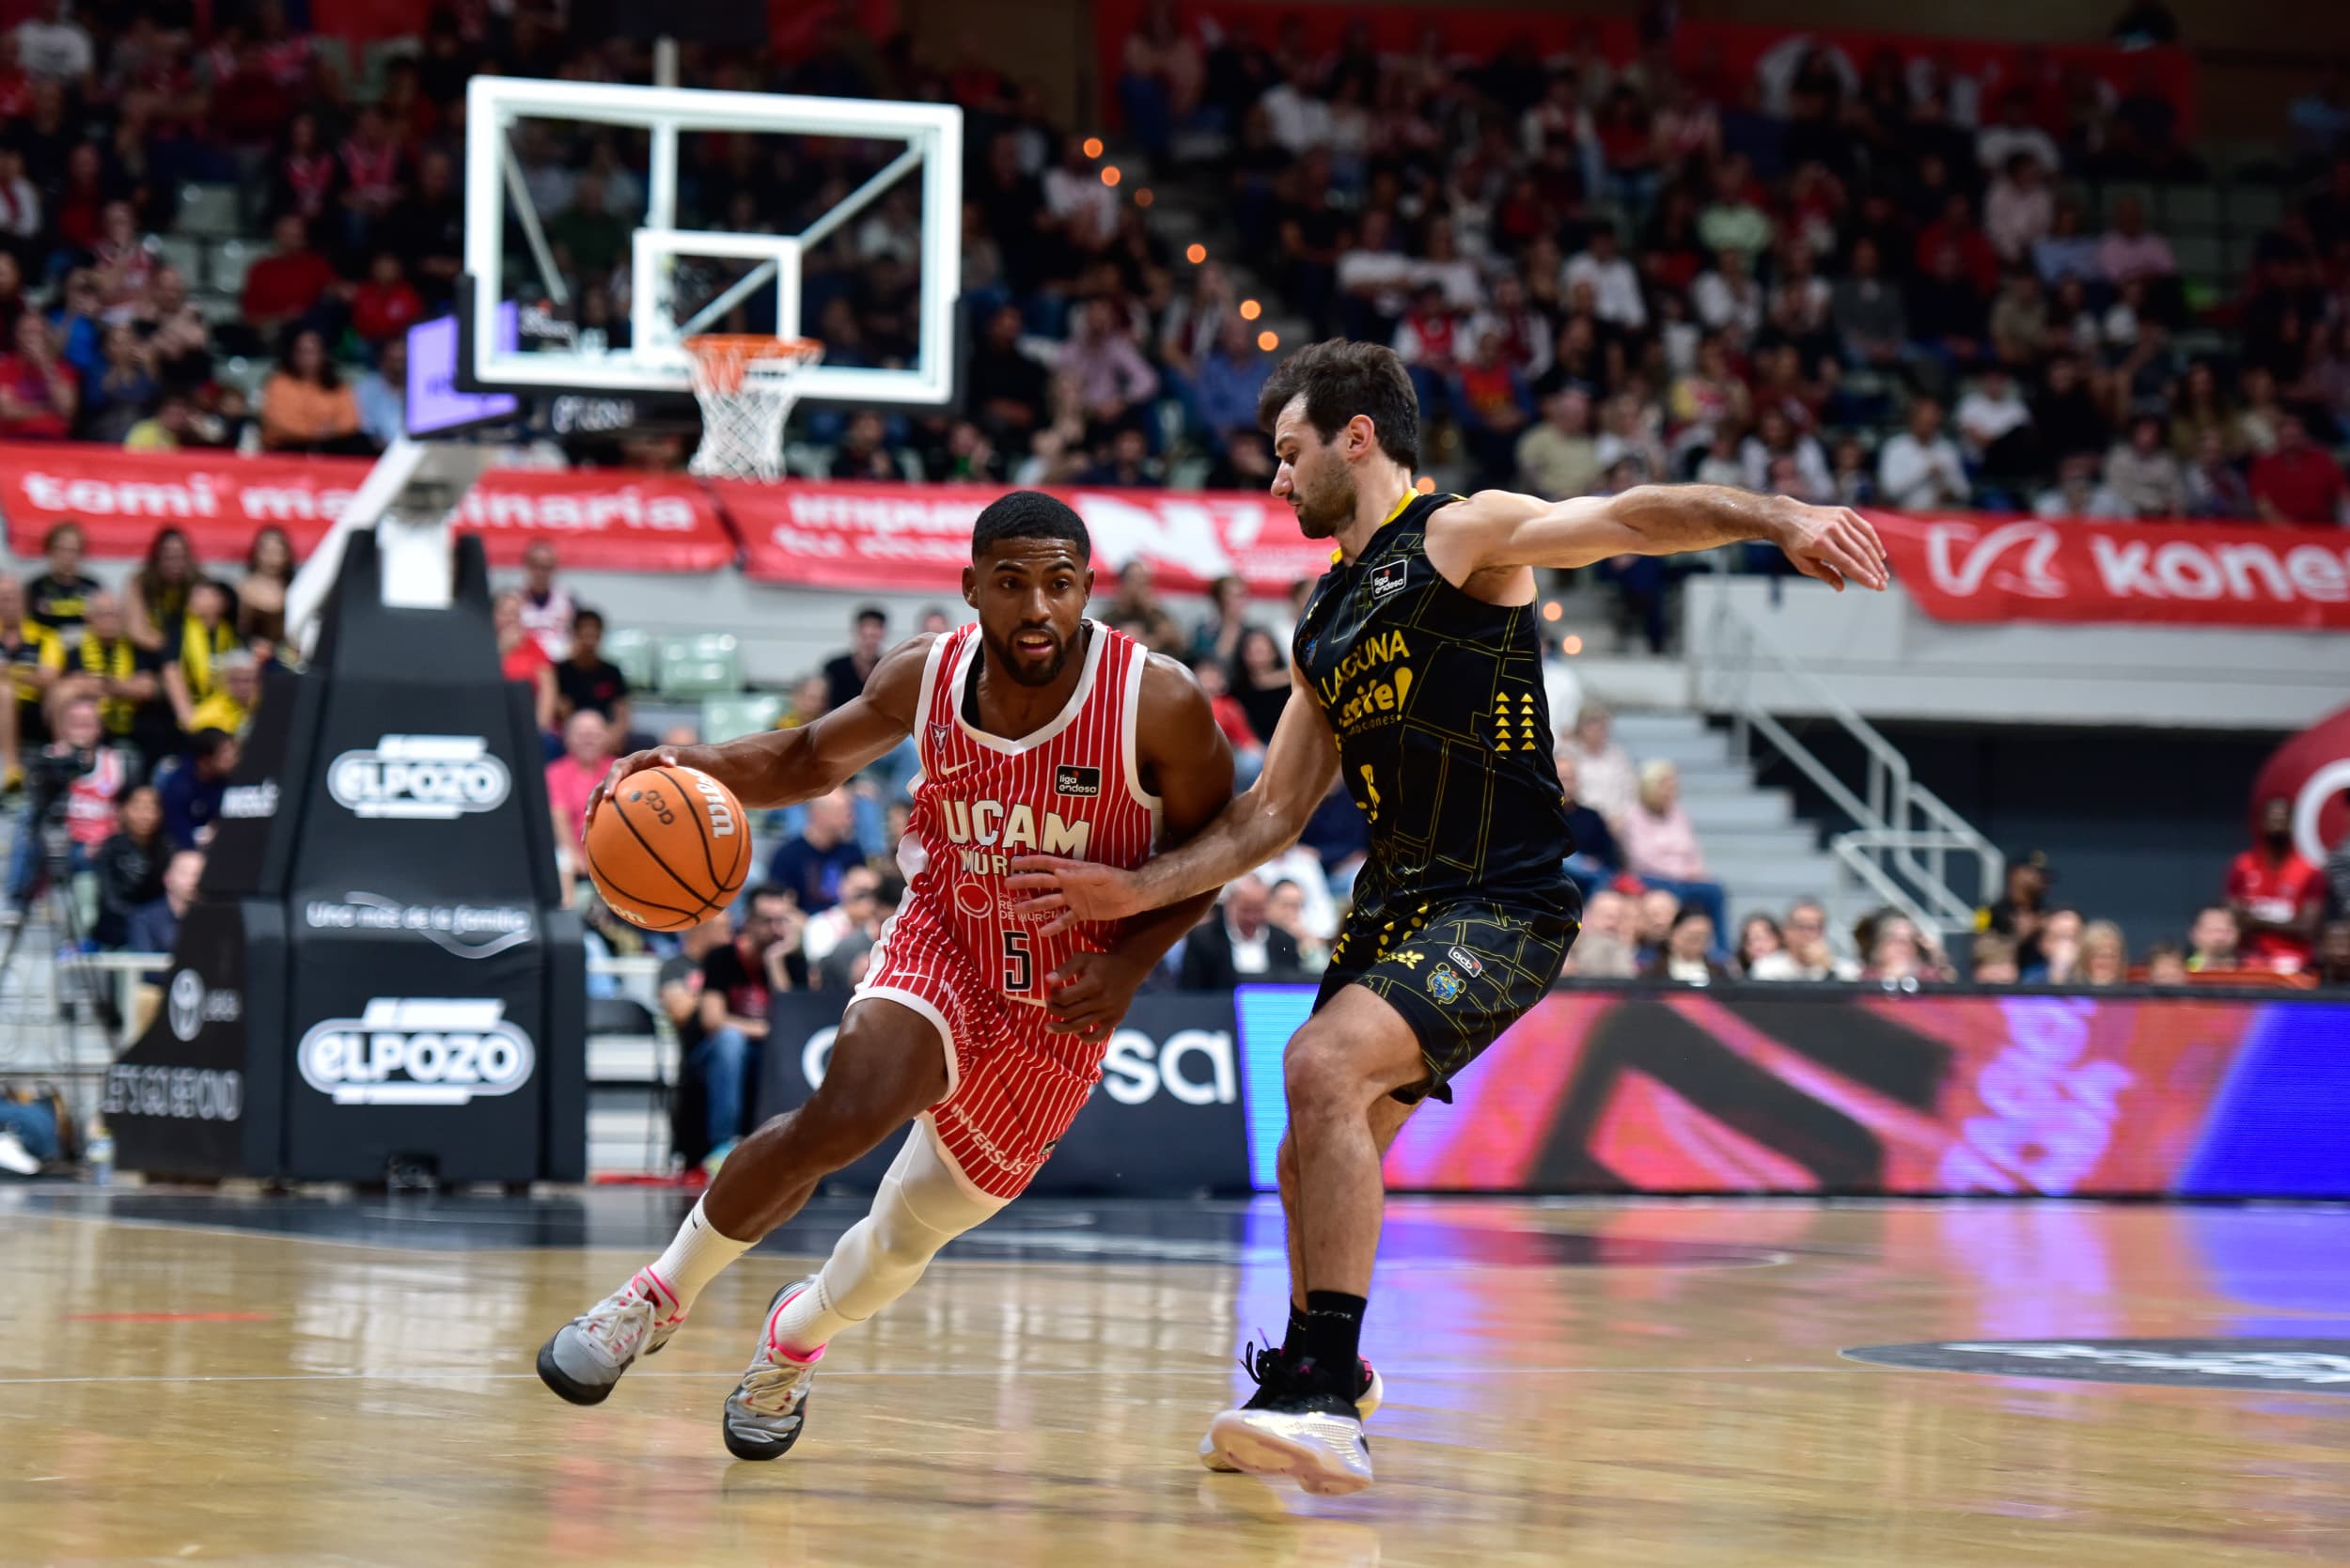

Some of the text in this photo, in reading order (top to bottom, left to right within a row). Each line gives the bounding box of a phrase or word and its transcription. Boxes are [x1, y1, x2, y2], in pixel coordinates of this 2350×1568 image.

[1058, 784, 1097, 793] endesa
[1059, 774, 1077, 785] liga
[942, 799, 1091, 862] UCAM
[1003, 930, 1033, 993] 5
[1452, 950, 1473, 970] acb
[951, 1103, 1028, 1176] INVERSUS
